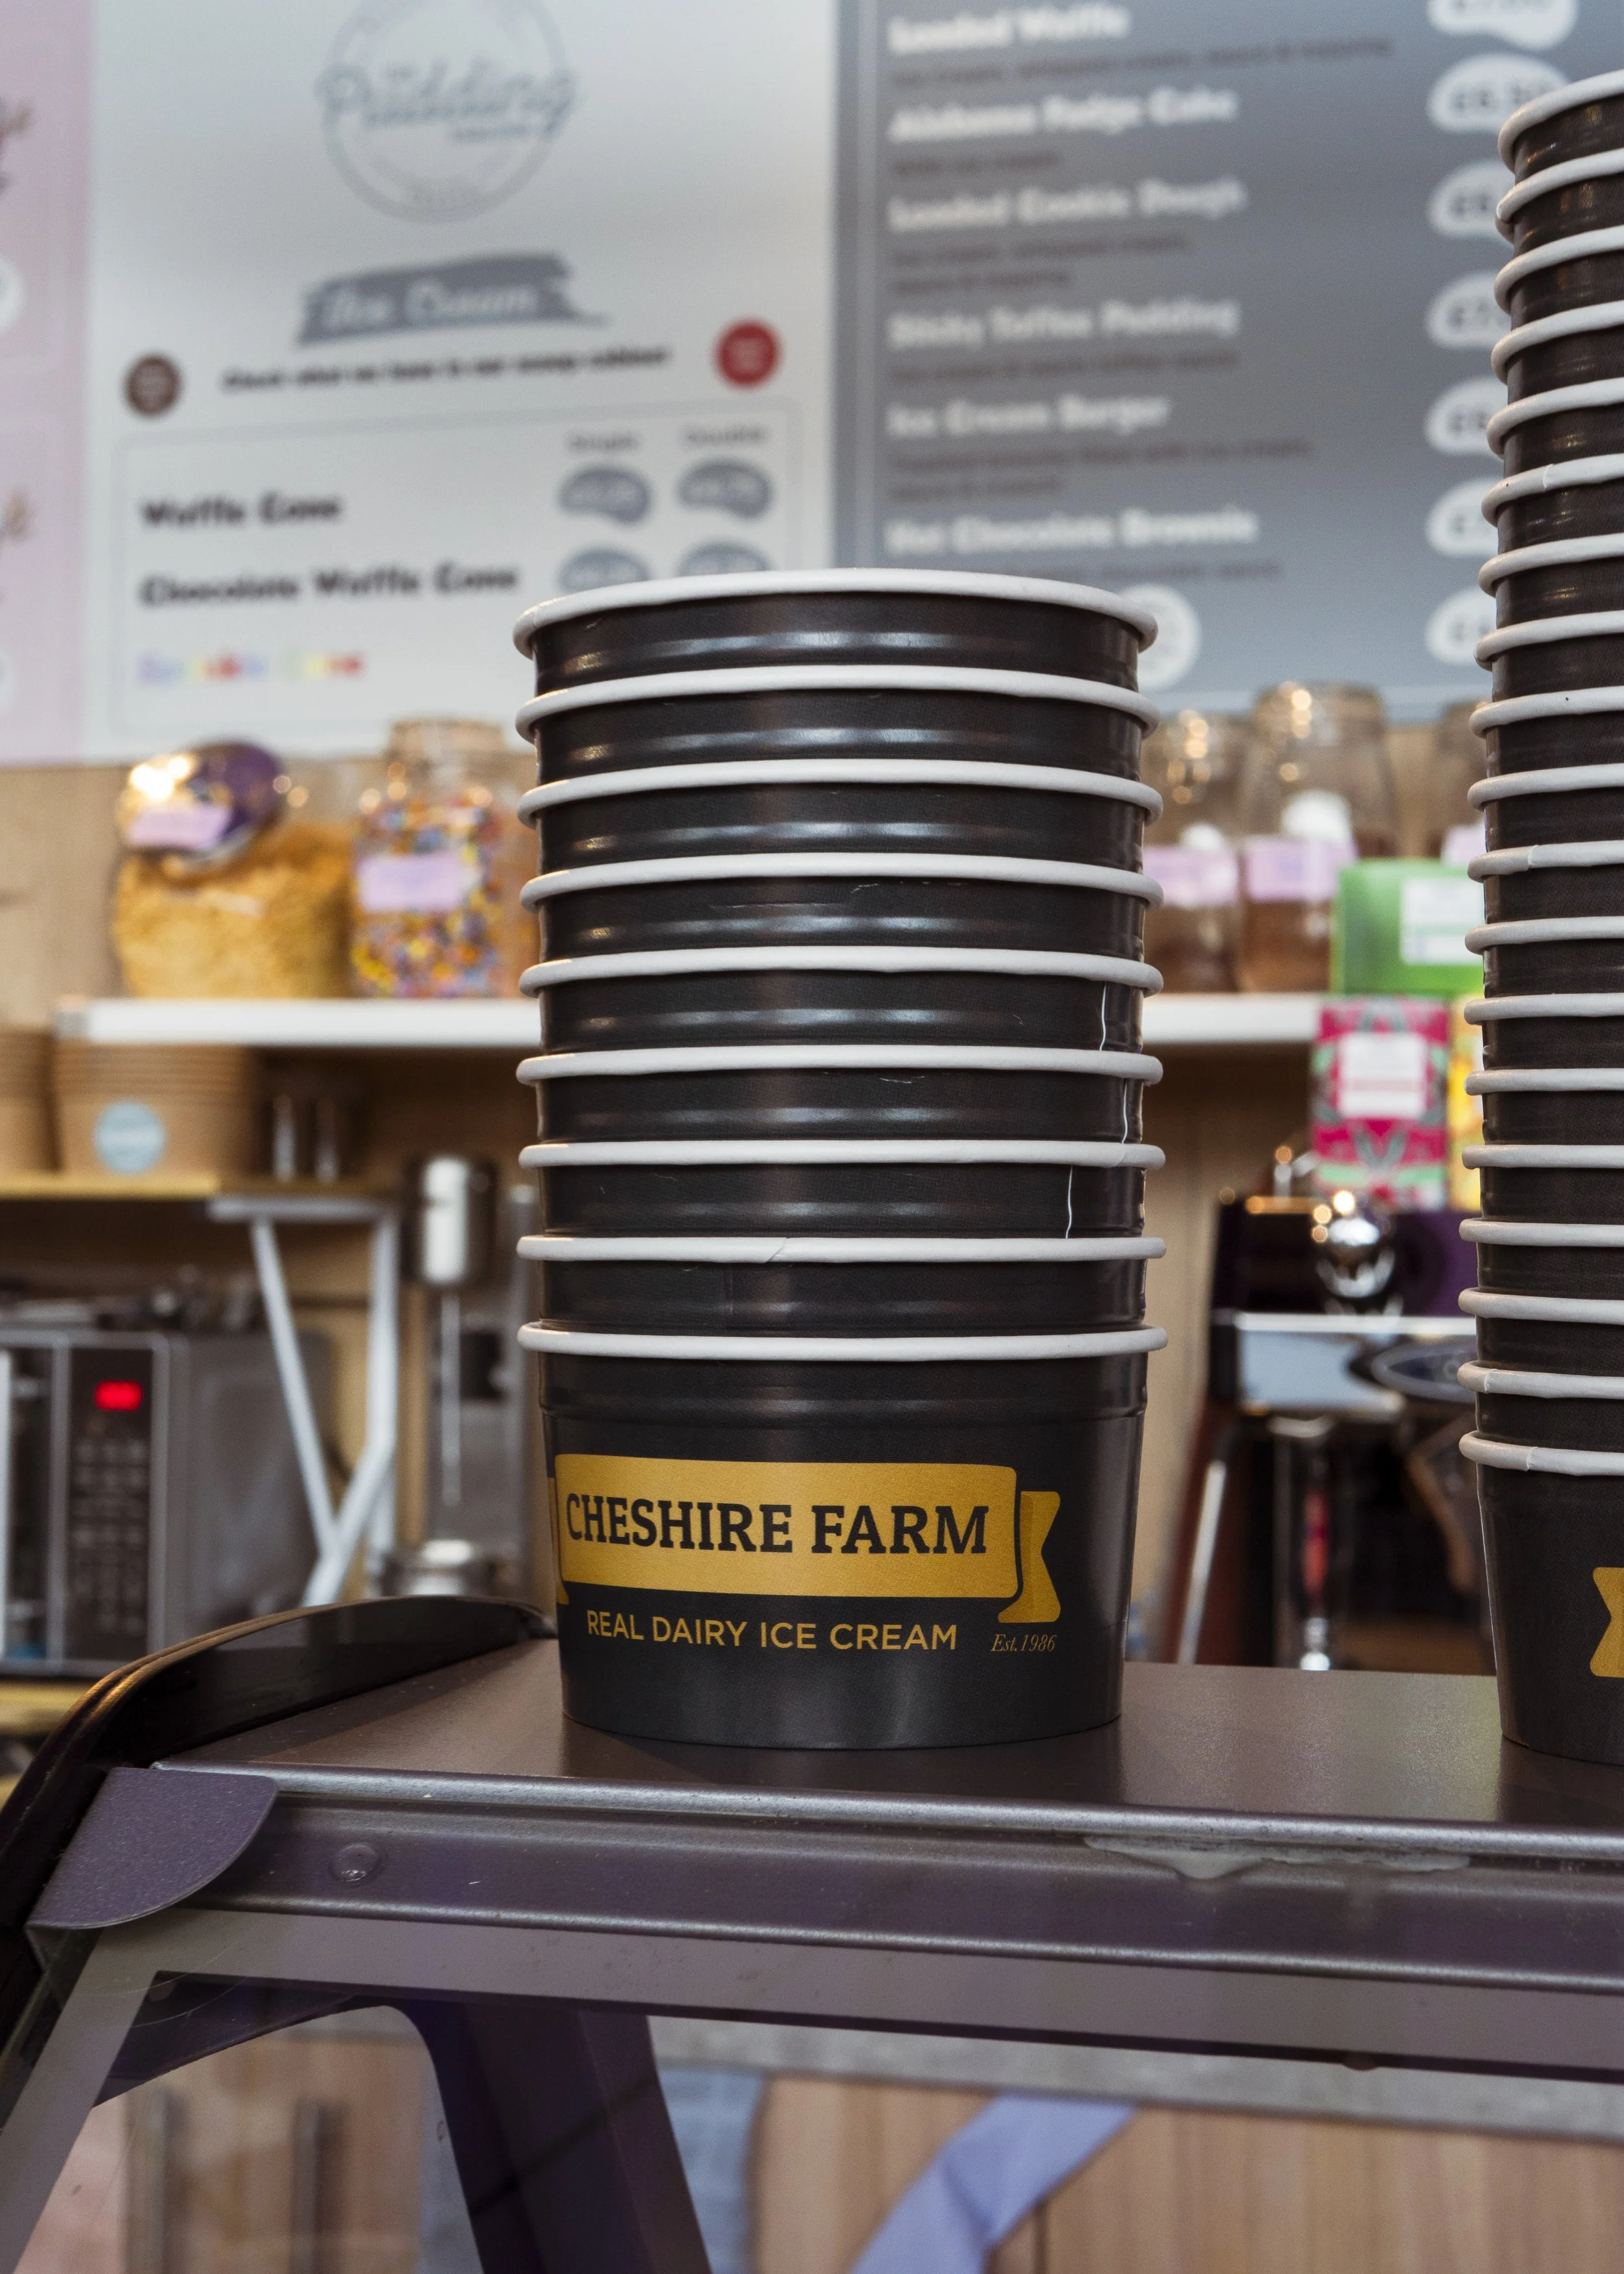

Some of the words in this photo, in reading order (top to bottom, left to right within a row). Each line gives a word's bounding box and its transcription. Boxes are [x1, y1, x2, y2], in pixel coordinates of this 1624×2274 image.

[138, 495, 249, 530] Waffle
[137, 572, 306, 611] Chocolate
[311, 563, 425, 599] Waffle
[566, 1492, 793, 1553] CHESHIRE
[811, 1505, 989, 1554] FARM
[587, 1609, 645, 1641] REAL
[652, 1616, 748, 1646] DAIRY
[759, 1622, 817, 1649] ICE
[830, 1624, 957, 1650] CREAM
[990, 1633, 1058, 1653] Est.1986
